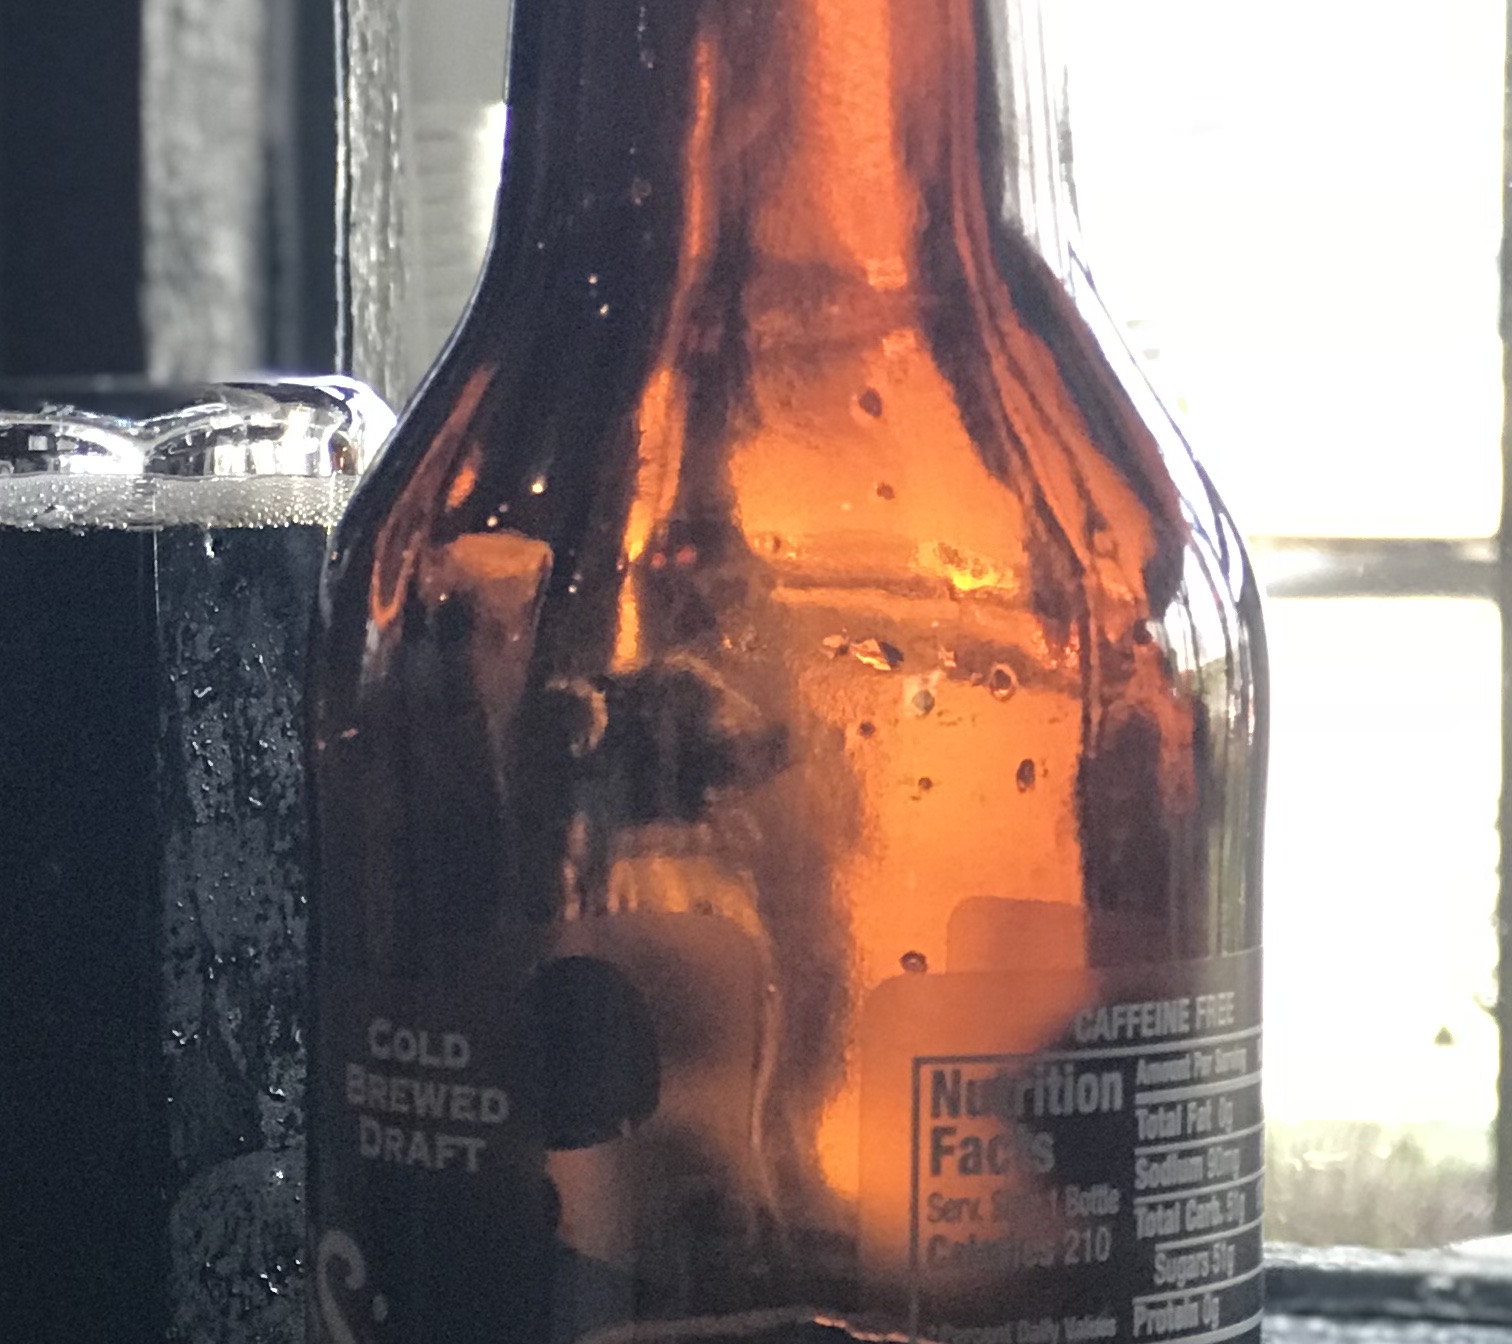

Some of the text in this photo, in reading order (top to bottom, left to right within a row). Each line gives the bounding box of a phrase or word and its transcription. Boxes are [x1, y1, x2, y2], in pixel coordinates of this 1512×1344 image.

[1074, 991, 1235, 1043] CAFFEINE FREE
[367, 1018, 470, 1069] COLD
[345, 1063, 510, 1124] BREWED
[359, 1114, 487, 1172] DRAFT
[1135, 1104, 1182, 1141] Total
[1134, 1201, 1180, 1240] Total
[1064, 1226, 1112, 1265] 210
[1153, 1250, 1209, 1288] Sugars
